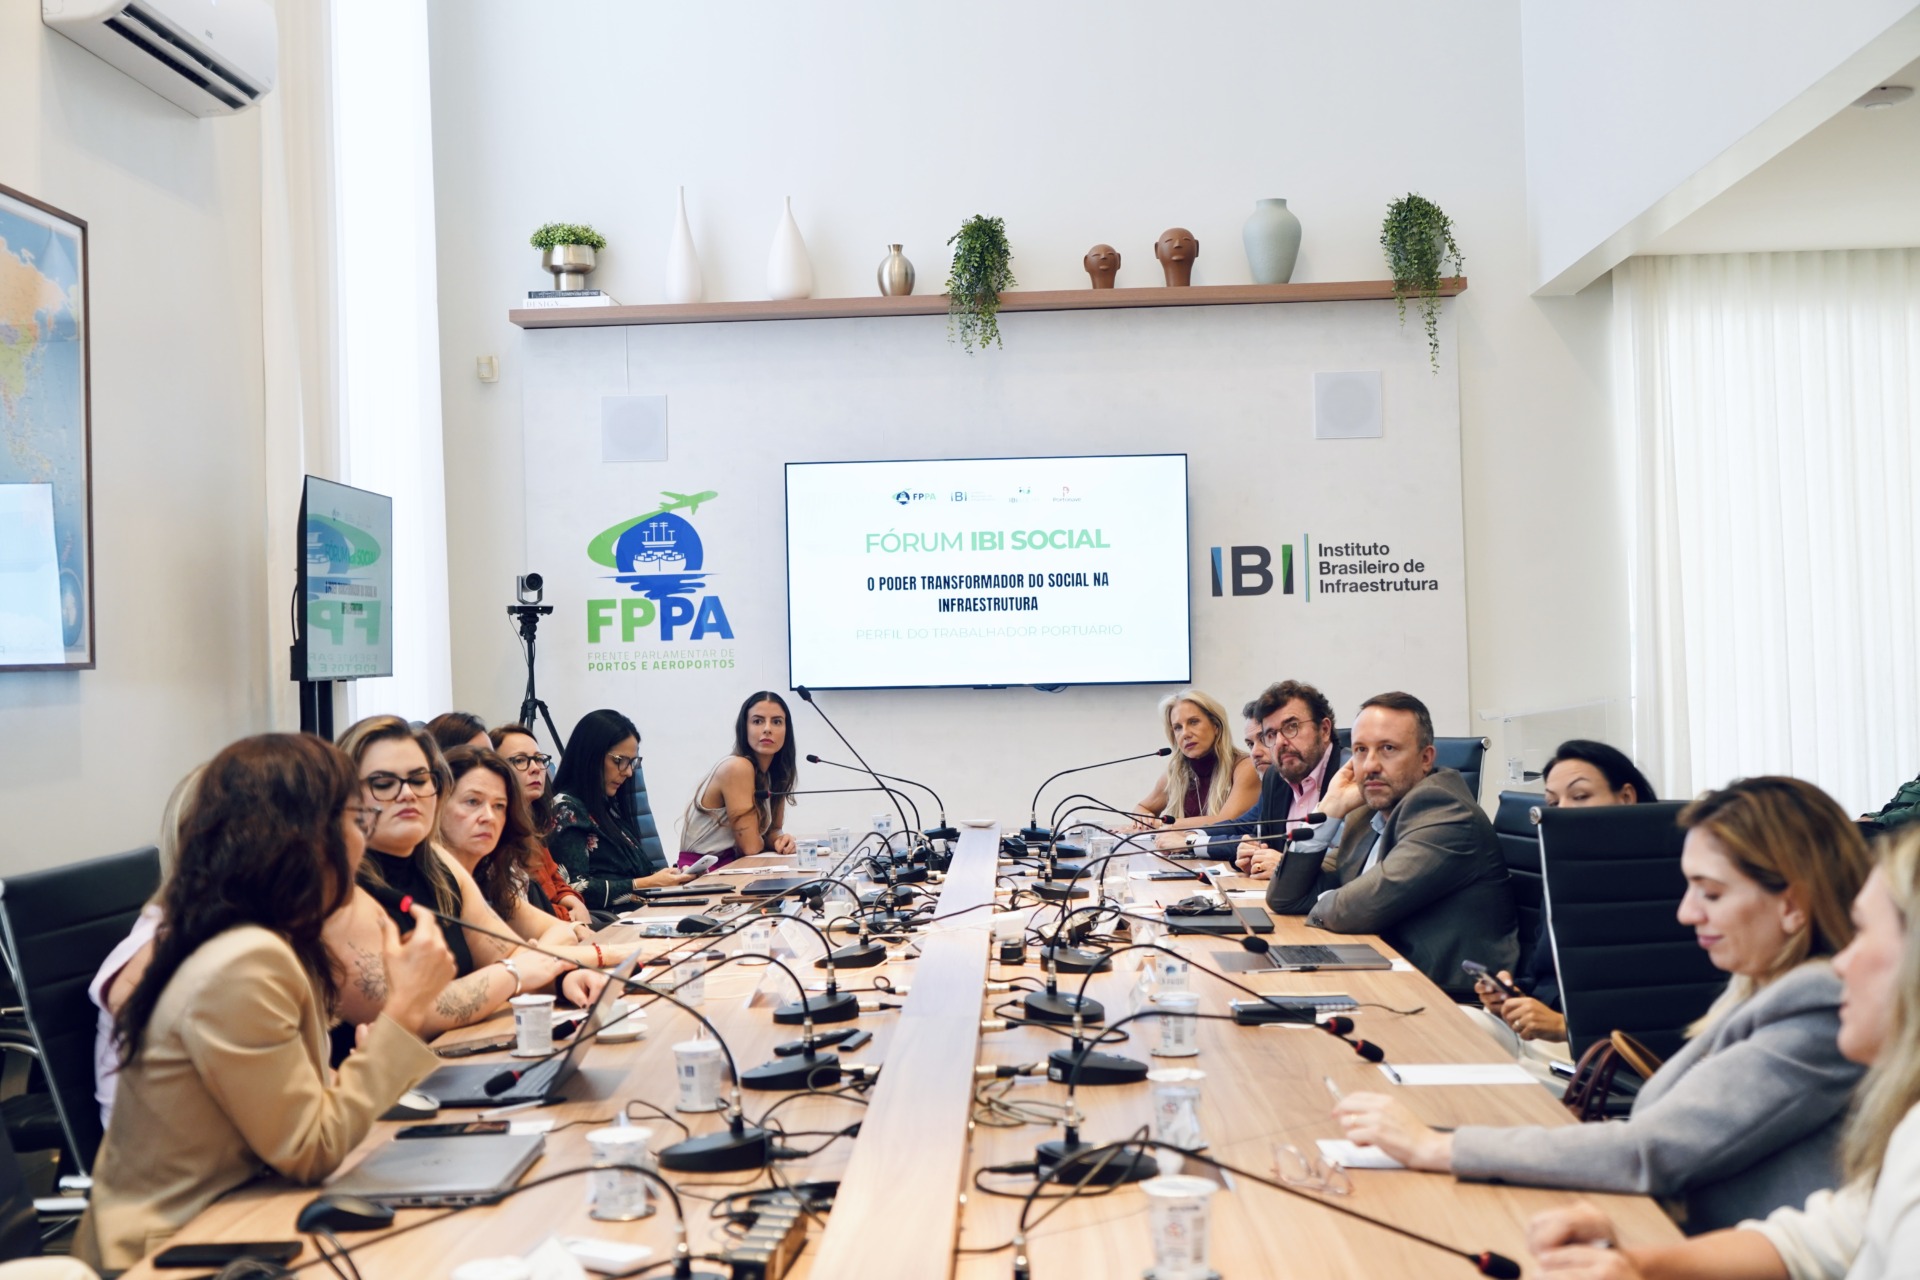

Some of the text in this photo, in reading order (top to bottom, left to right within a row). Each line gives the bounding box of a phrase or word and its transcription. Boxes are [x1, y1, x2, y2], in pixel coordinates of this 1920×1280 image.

[913, 493, 937, 501] FPPA
[866, 527, 1111, 554] FÓRUM IBI SOCIAL
[1318, 542, 1390, 557] Instituto
[1210, 543, 1295, 597] IBI
[1319, 558, 1426, 576] Brasileiro de
[867, 571, 1109, 592] O PODER TRANSFORMADOR DO SOCIAL NA
[1319, 577, 1439, 594] Infraestrutura
[938, 596, 1039, 613] INFRAESTRUTURA
[587, 595, 735, 644] FPPA
[856, 628, 902, 640] PERFIL
[907, 627, 929, 640] DO
[933, 626, 1038, 639] TRABALHADOR
[587, 648, 735, 661] FRENTE PARLAMENTAR DE
[588, 659, 735, 672] PORTOS E AEROPORTOS
